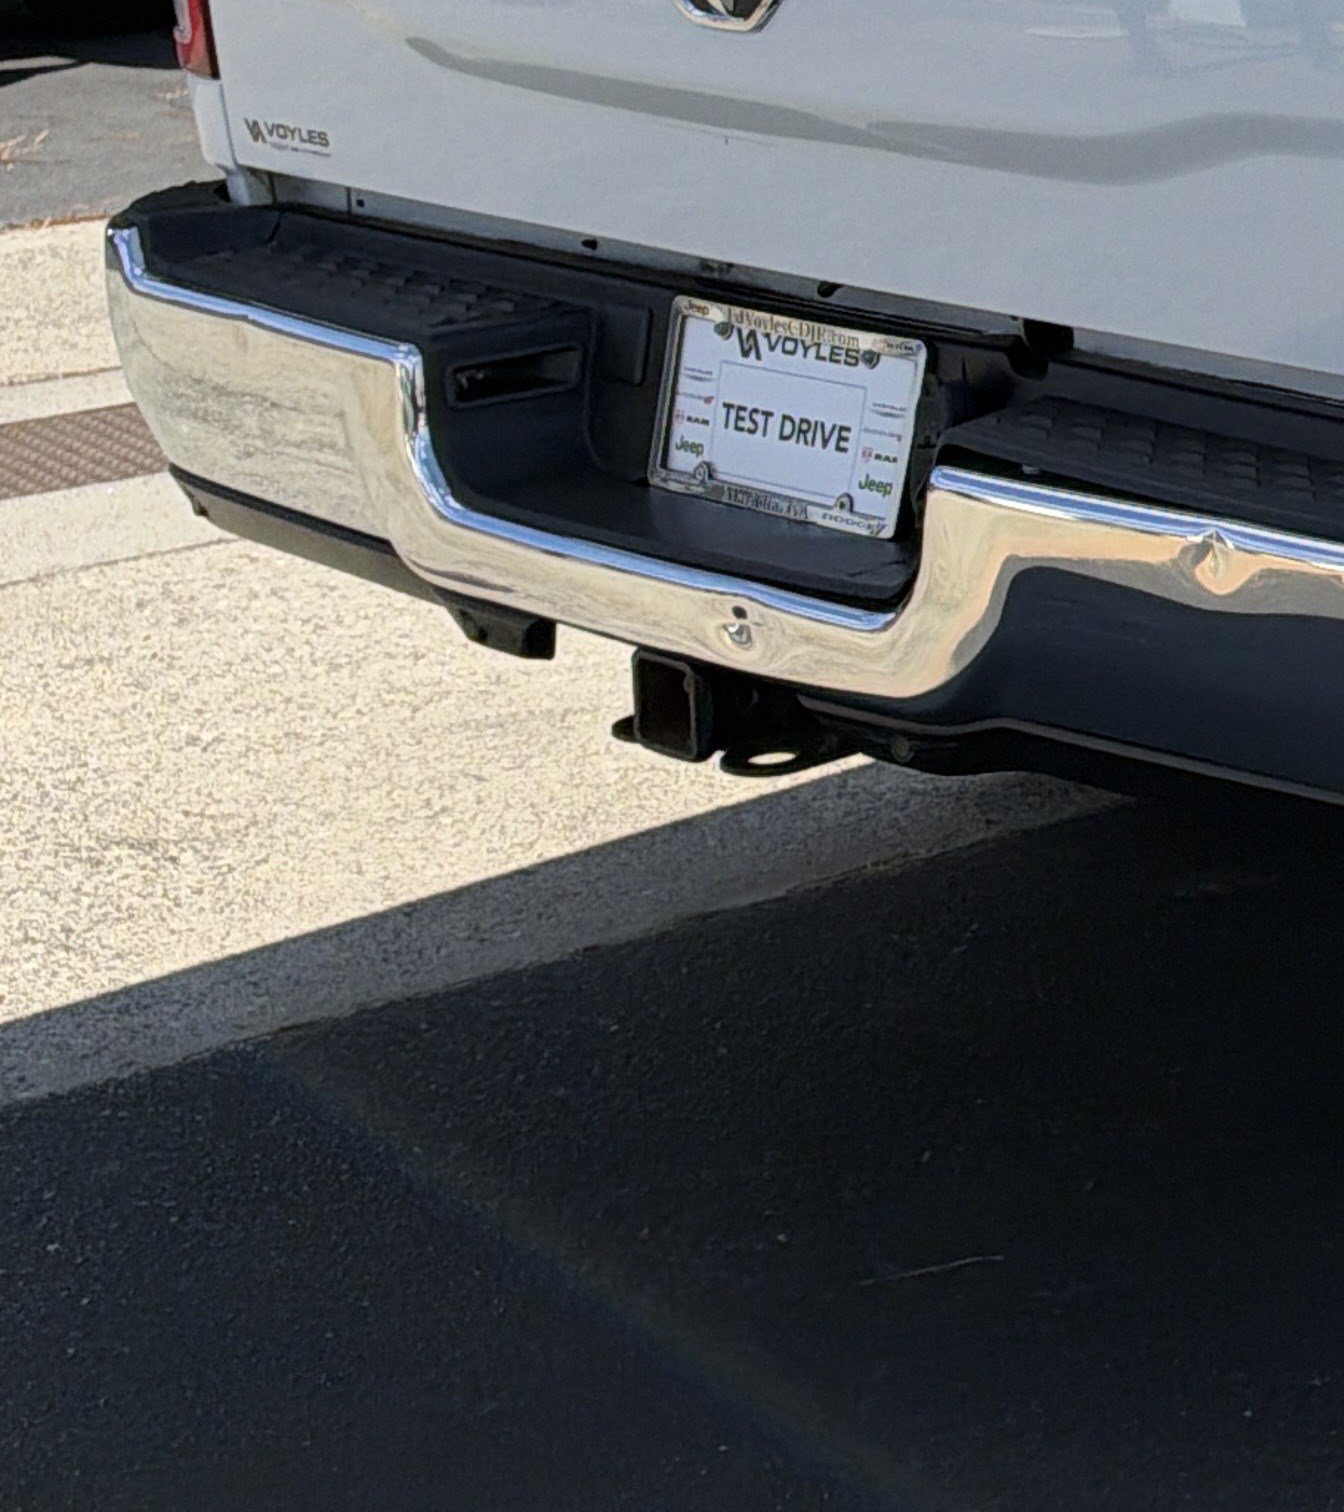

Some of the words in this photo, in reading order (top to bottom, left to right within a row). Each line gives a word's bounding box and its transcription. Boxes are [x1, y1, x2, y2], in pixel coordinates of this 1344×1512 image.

[263, 121, 330, 148] VOYLES
[762, 331, 860, 368] VOYLES
[722, 401, 774, 437] TEST
[778, 414, 851, 454] DRIVE
[675, 434, 704, 458] Jeep
[858, 473, 893, 498] Jeep
